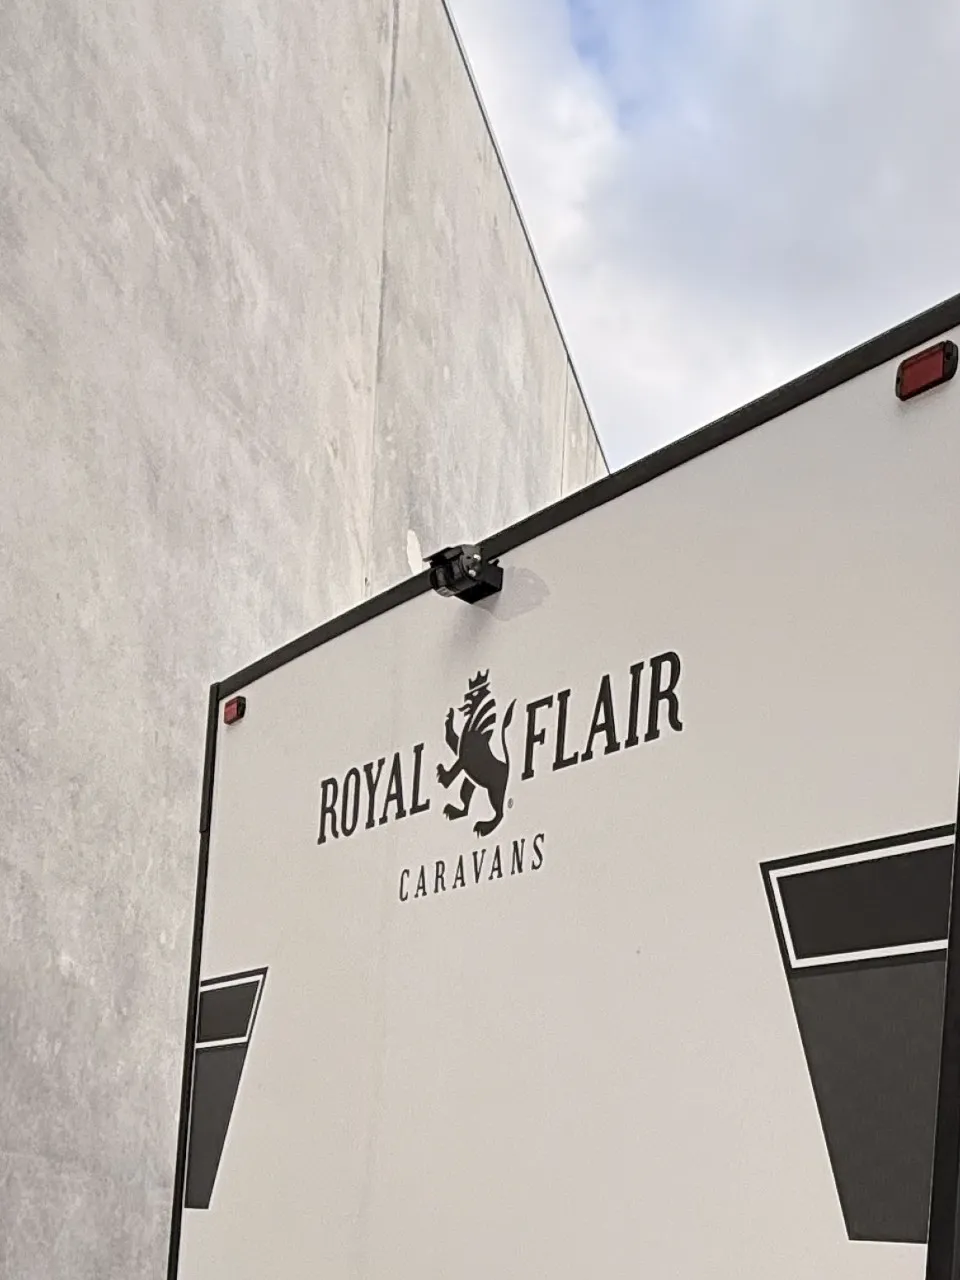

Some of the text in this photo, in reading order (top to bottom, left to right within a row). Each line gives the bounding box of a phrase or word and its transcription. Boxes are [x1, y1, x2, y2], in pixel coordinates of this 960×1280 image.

[316, 651, 683, 846] ROYAL FLAIR
[398, 832, 546, 902] CARAVANS
